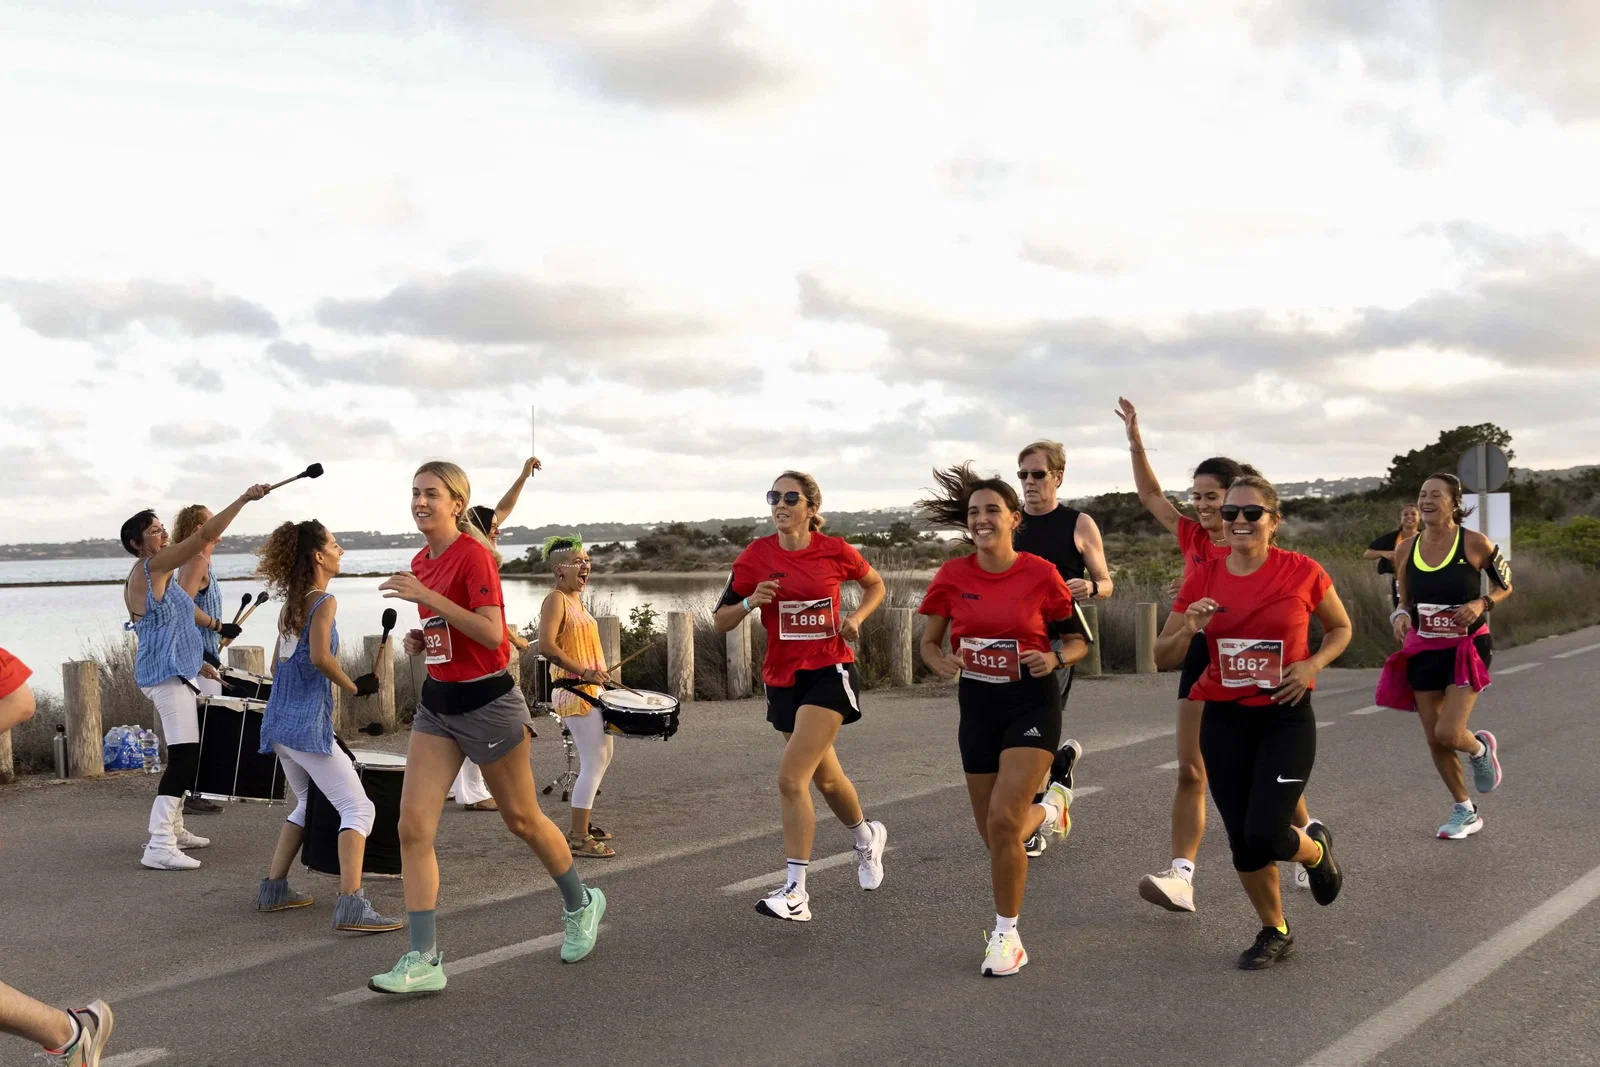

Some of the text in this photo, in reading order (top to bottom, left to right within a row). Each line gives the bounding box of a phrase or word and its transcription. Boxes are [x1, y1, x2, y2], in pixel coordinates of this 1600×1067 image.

[790, 614, 825, 626] 1880
[972, 652, 1007, 668] 1912
[1228, 658, 1269, 671] 1867
